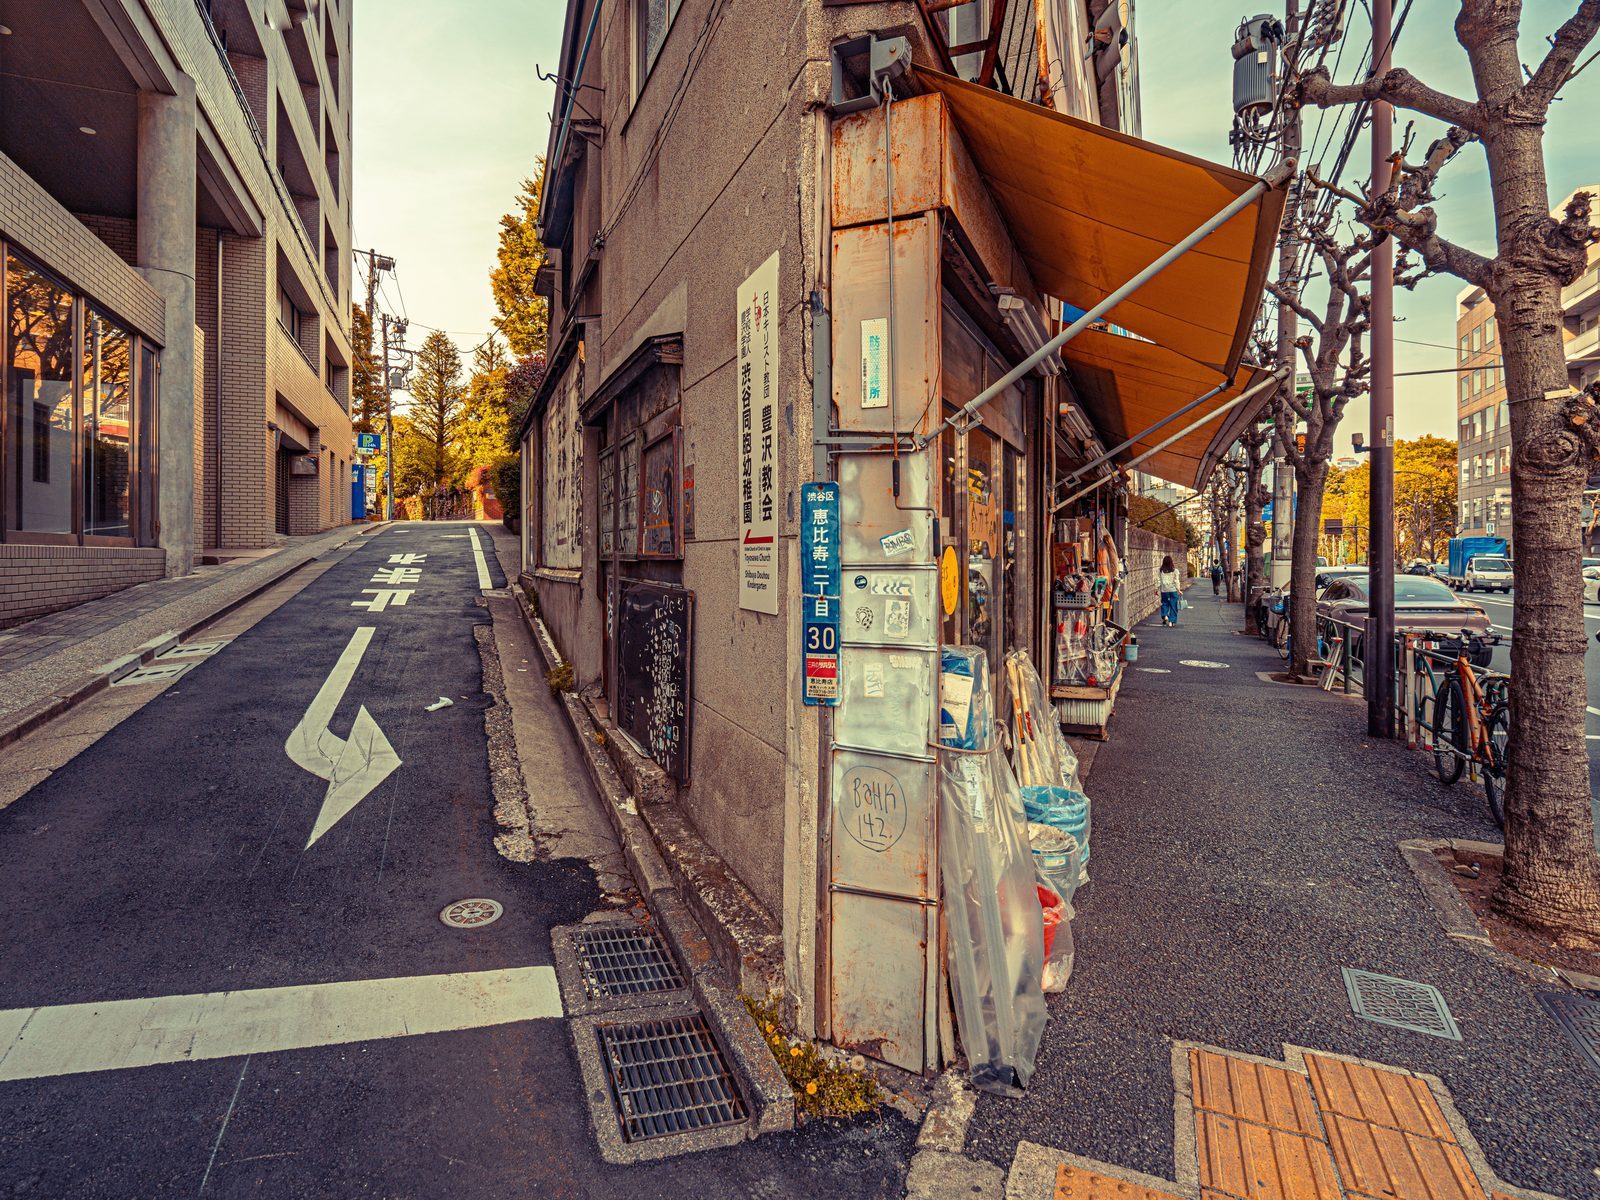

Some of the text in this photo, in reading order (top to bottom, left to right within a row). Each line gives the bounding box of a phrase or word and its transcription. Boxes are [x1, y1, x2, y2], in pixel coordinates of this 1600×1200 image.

[742, 362, 752, 524] 渋谷同胞幼稚園
[761, 404, 773, 521] 豊沢教会
[807, 490, 835, 502] 渋谷区
[812, 508, 830, 617] 恵比寿二丁目
[807, 626, 836, 650] 30
